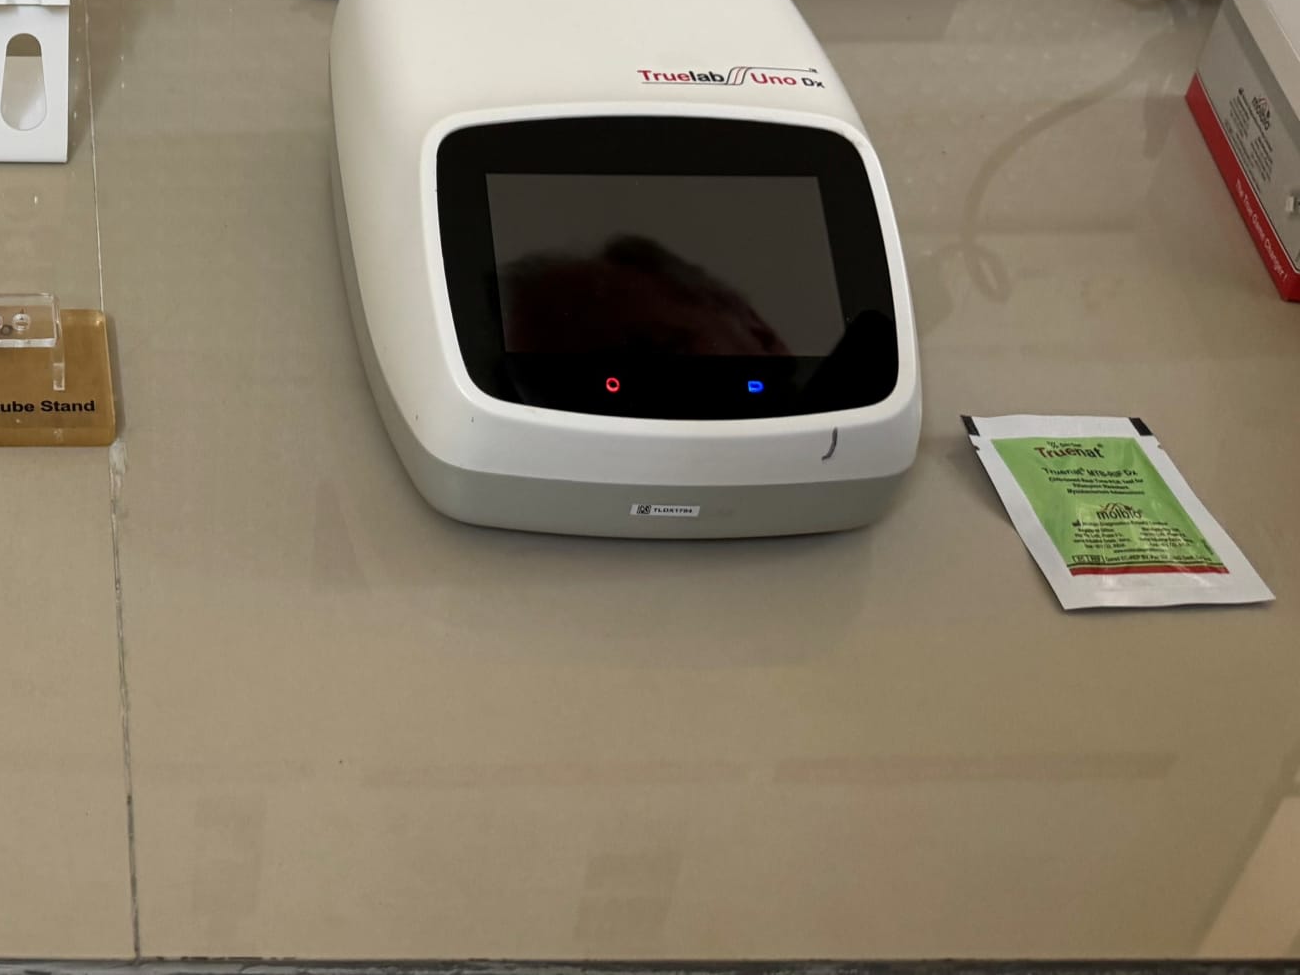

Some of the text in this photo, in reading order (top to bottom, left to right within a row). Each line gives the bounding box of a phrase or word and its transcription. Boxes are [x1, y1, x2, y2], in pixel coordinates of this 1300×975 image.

[637, 69, 826, 89] Truelab Uno Dx
[40, 400, 96, 414] Stand
